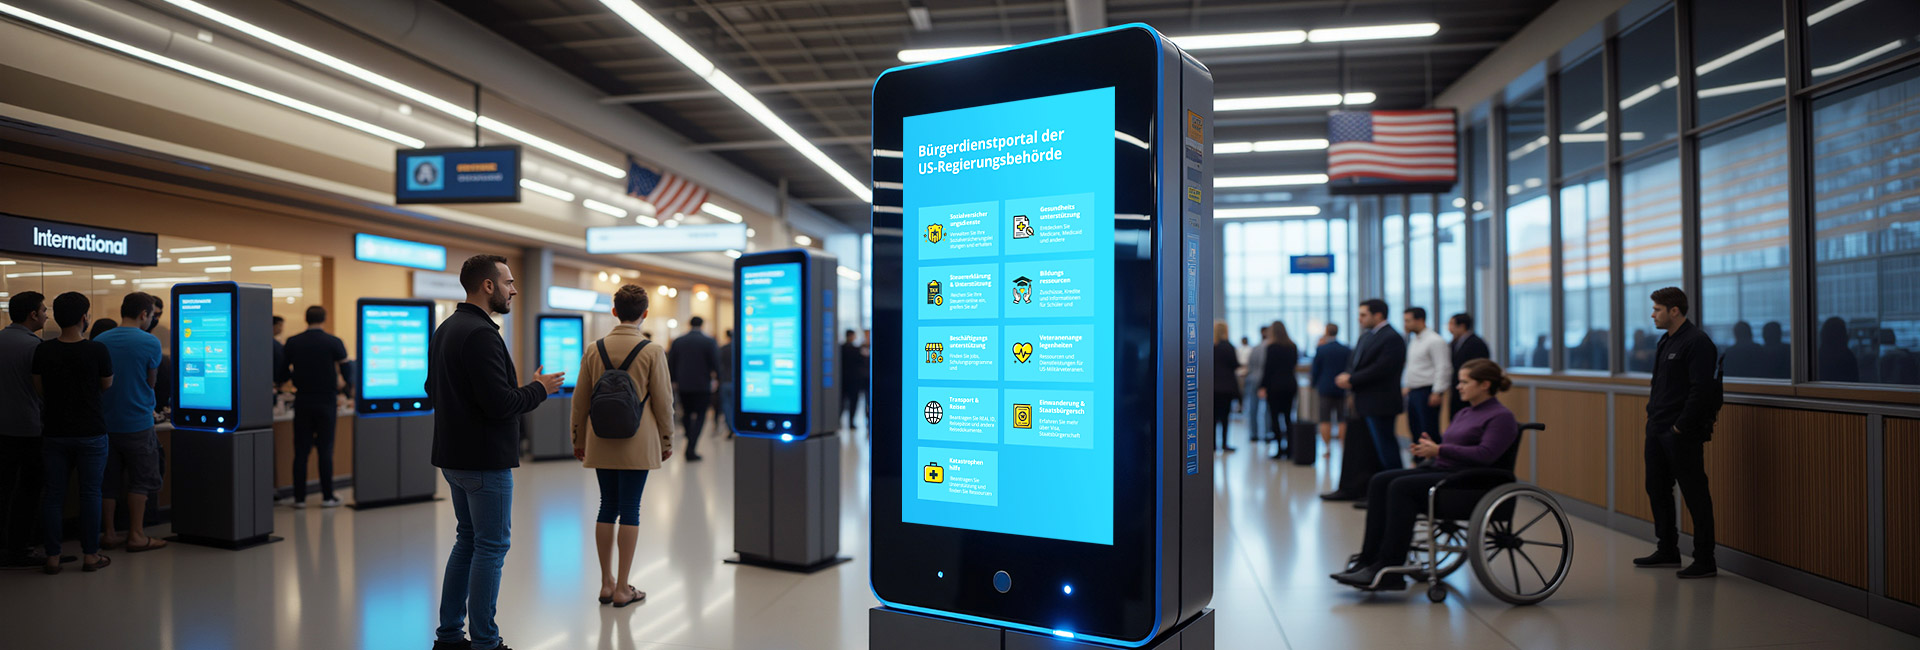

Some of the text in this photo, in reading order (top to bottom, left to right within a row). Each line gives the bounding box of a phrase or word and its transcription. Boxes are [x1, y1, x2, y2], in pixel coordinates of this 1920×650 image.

[918, 128, 1064, 158] Bürgerdienstportal der
[918, 147, 1062, 174] US-Regierungsbehörde
[34, 227, 128, 255] International
